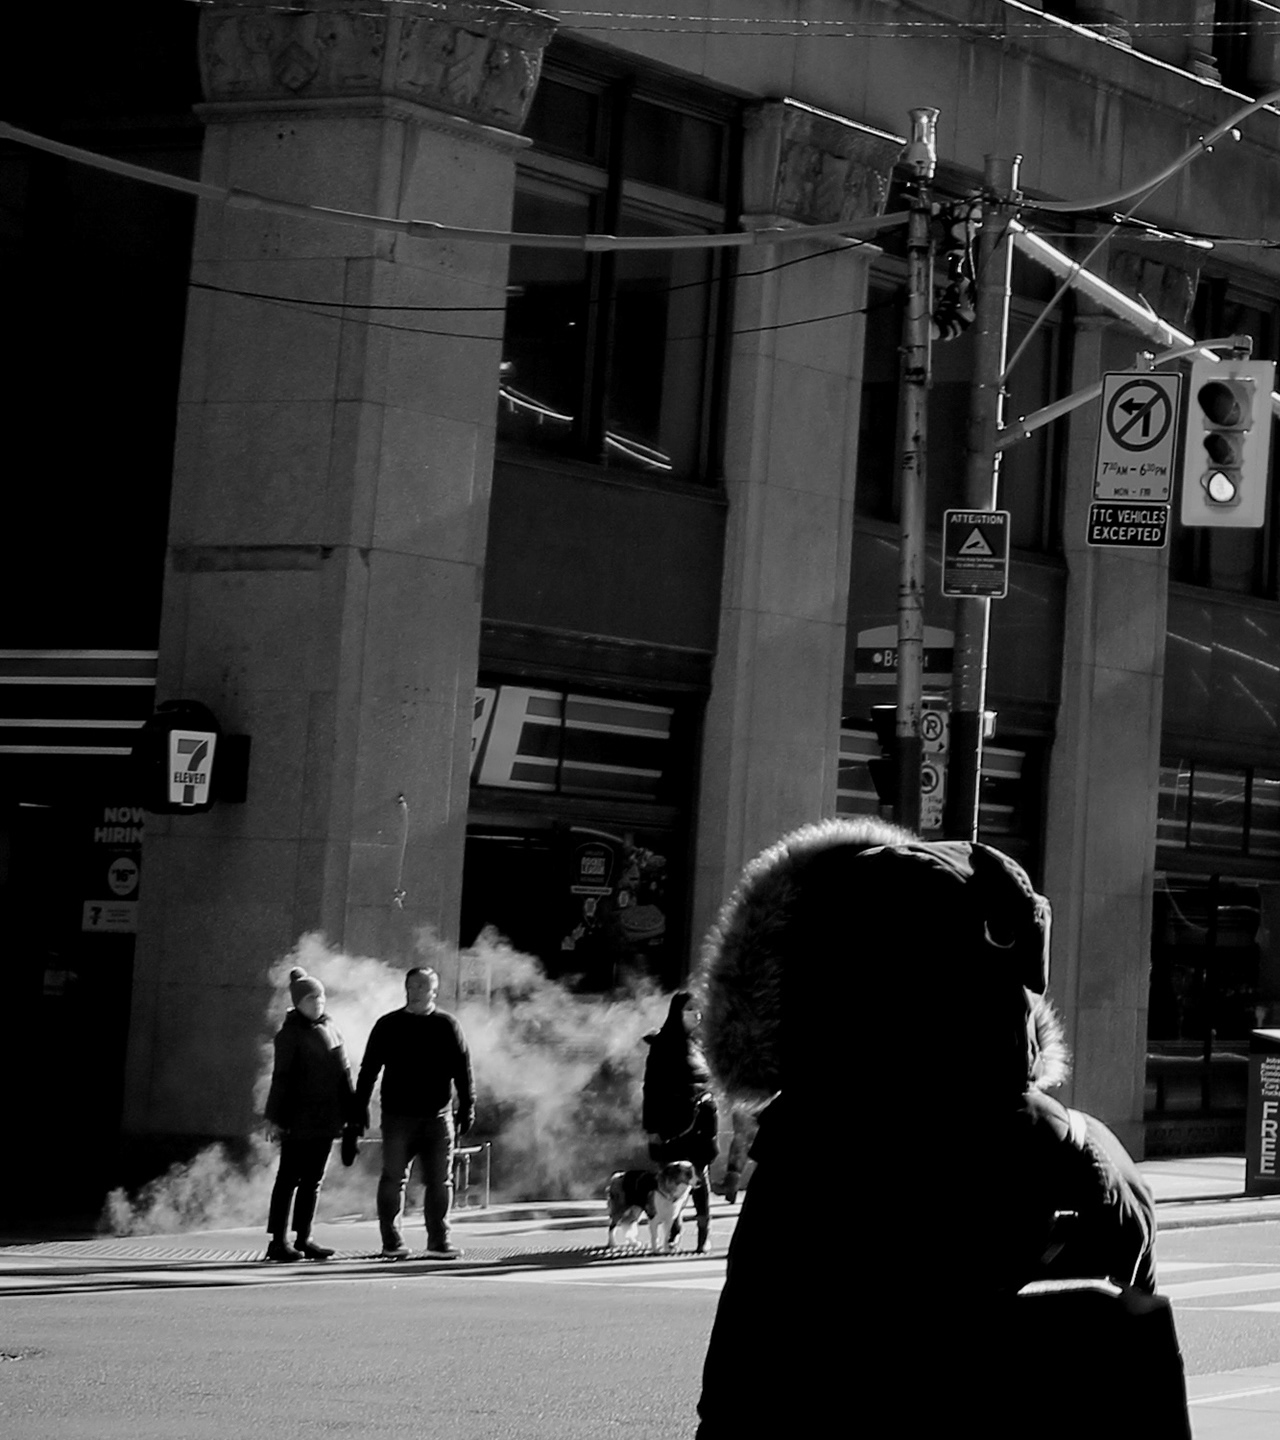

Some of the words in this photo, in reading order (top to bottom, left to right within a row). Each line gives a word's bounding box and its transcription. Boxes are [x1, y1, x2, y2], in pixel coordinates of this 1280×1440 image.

[1092, 508, 1113, 523] TTC
[1117, 509, 1167, 524] VEHICLES
[1093, 526, 1162, 541] EXCEPTED
[177, 738, 209, 804] 7
[103, 807, 144, 823] NOW
[94, 826, 142, 843] HIRIN
[1260, 1101, 1279, 1175] FREE
